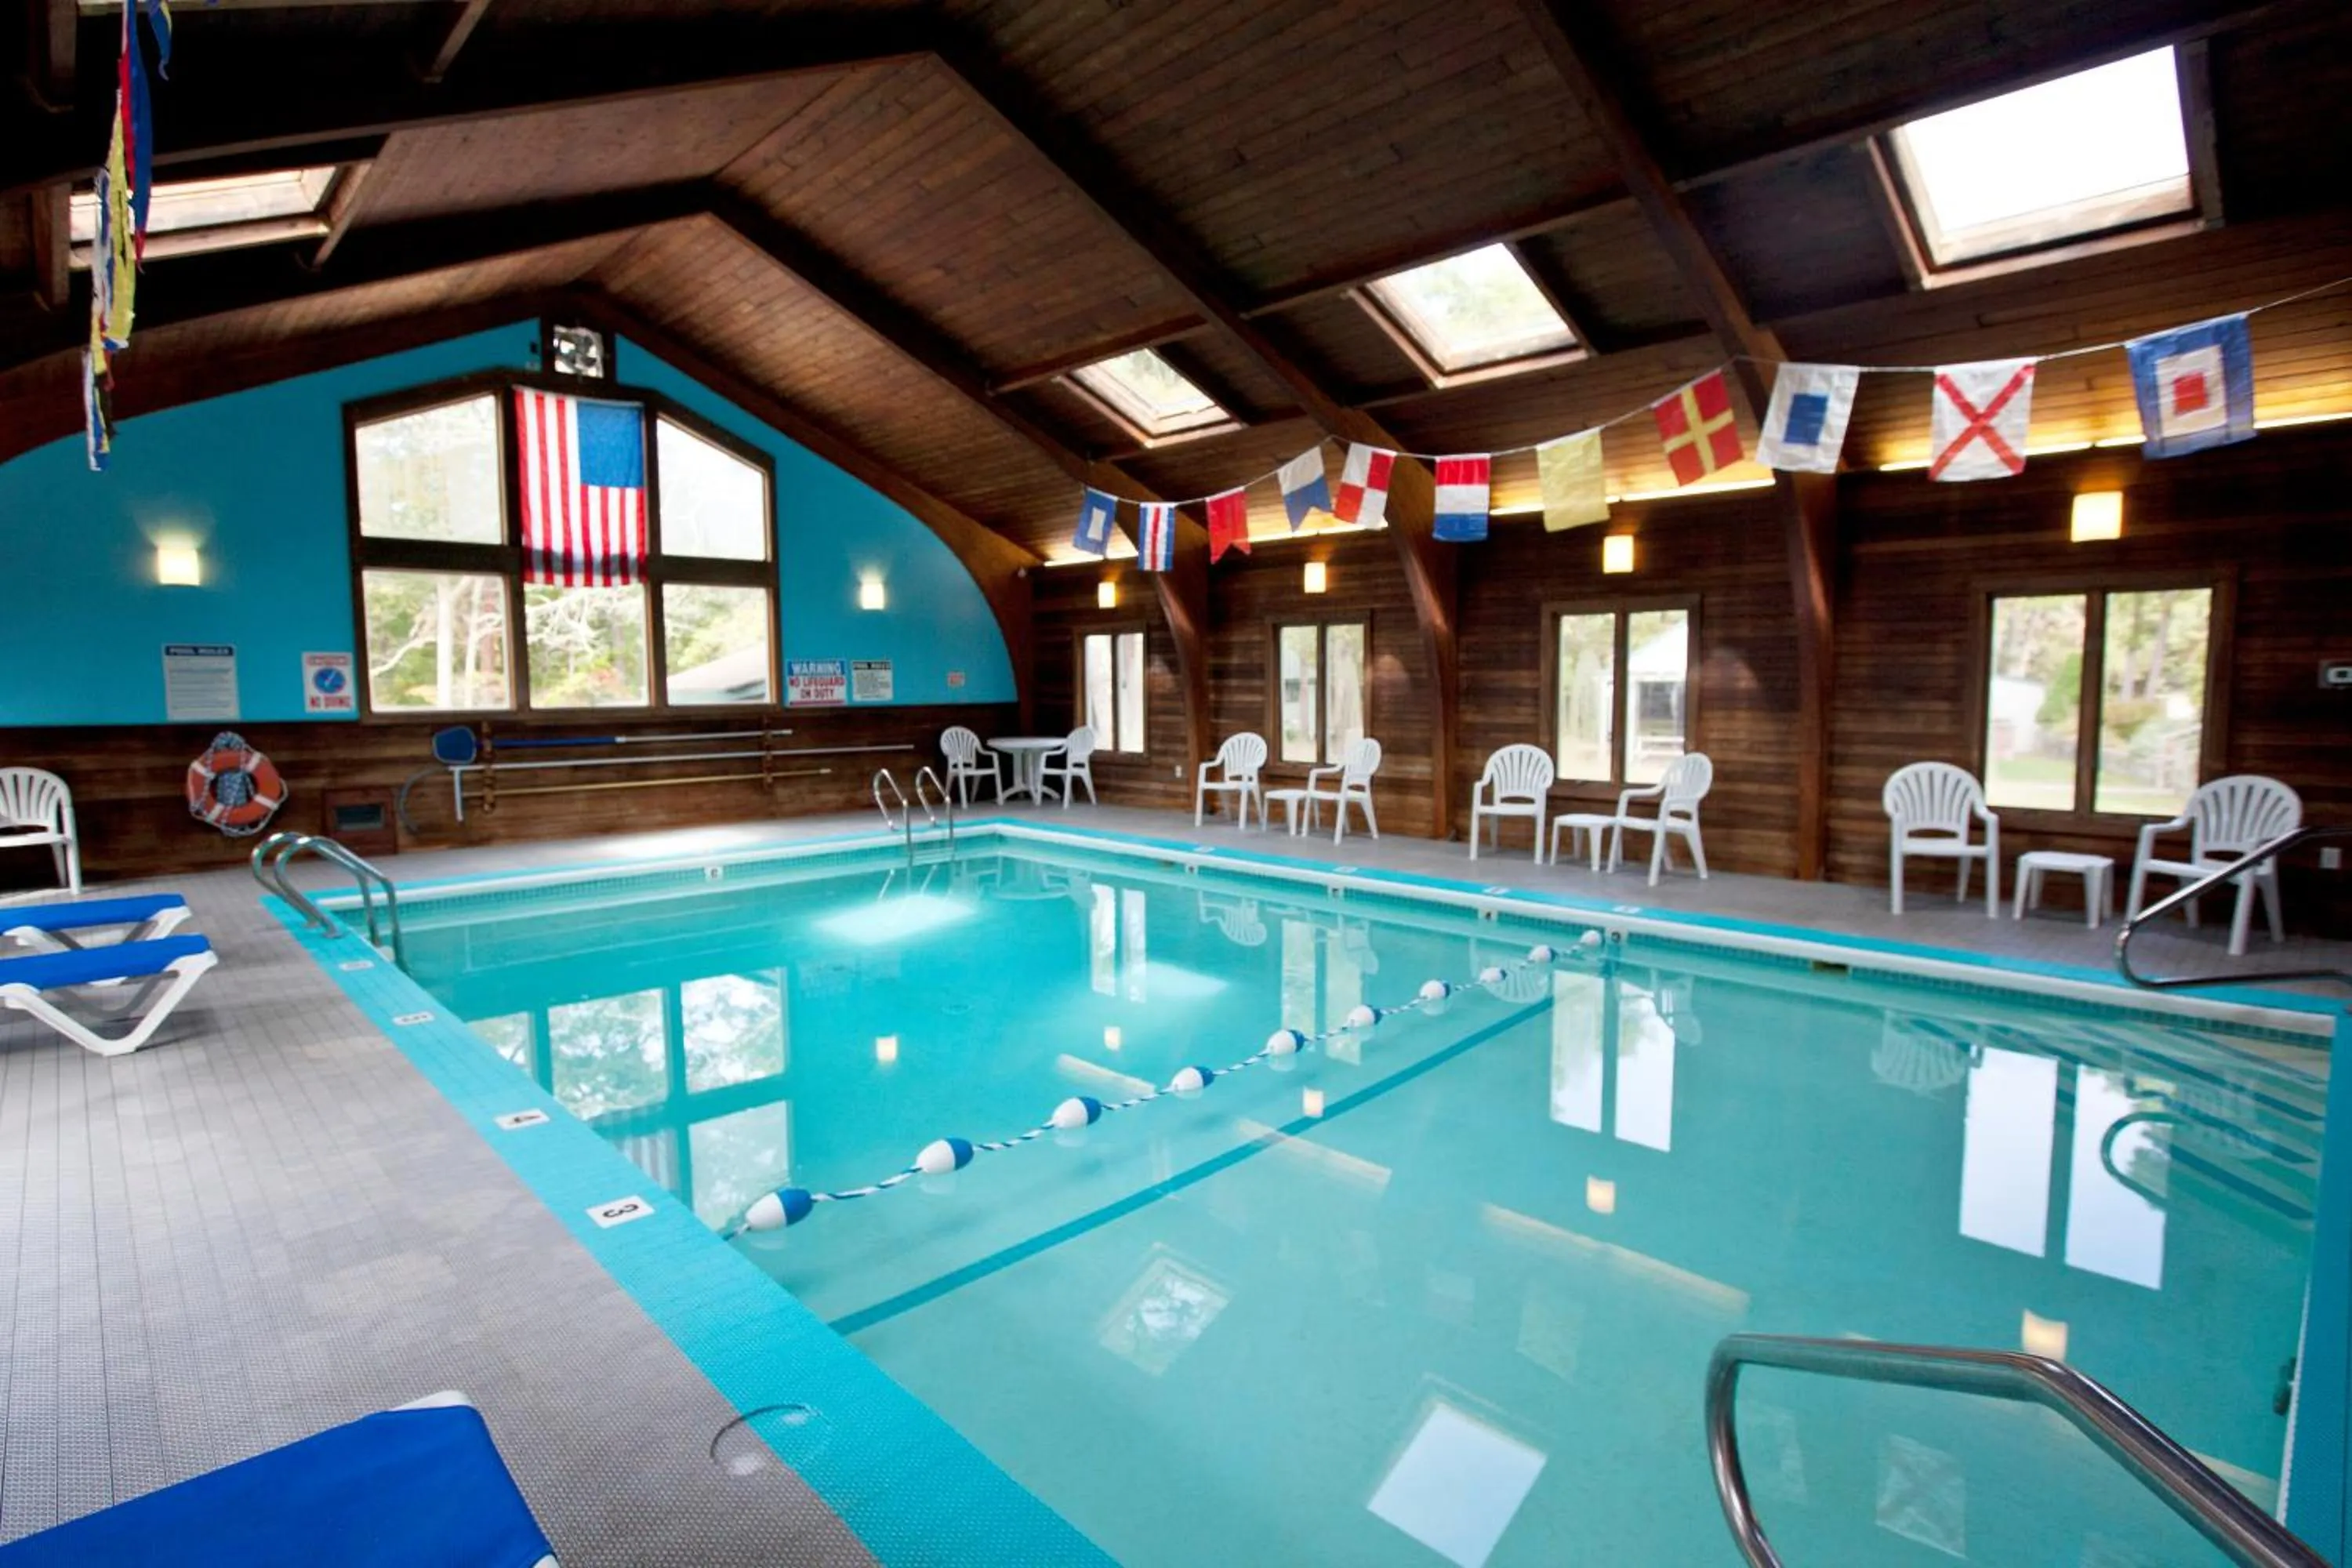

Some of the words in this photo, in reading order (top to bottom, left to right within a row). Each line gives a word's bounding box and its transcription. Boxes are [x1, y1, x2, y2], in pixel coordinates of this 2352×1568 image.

[791, 662, 842, 675] WARNING
[789, 677, 800, 687] NO
[803, 677, 845, 686] LIFEGUARD
[800, 689, 811, 699] ON
[815, 688, 834, 699] DUTY
[310, 696, 321, 708] NO
[324, 695, 350, 707] DIVING
[601, 1203, 639, 1218] 3
